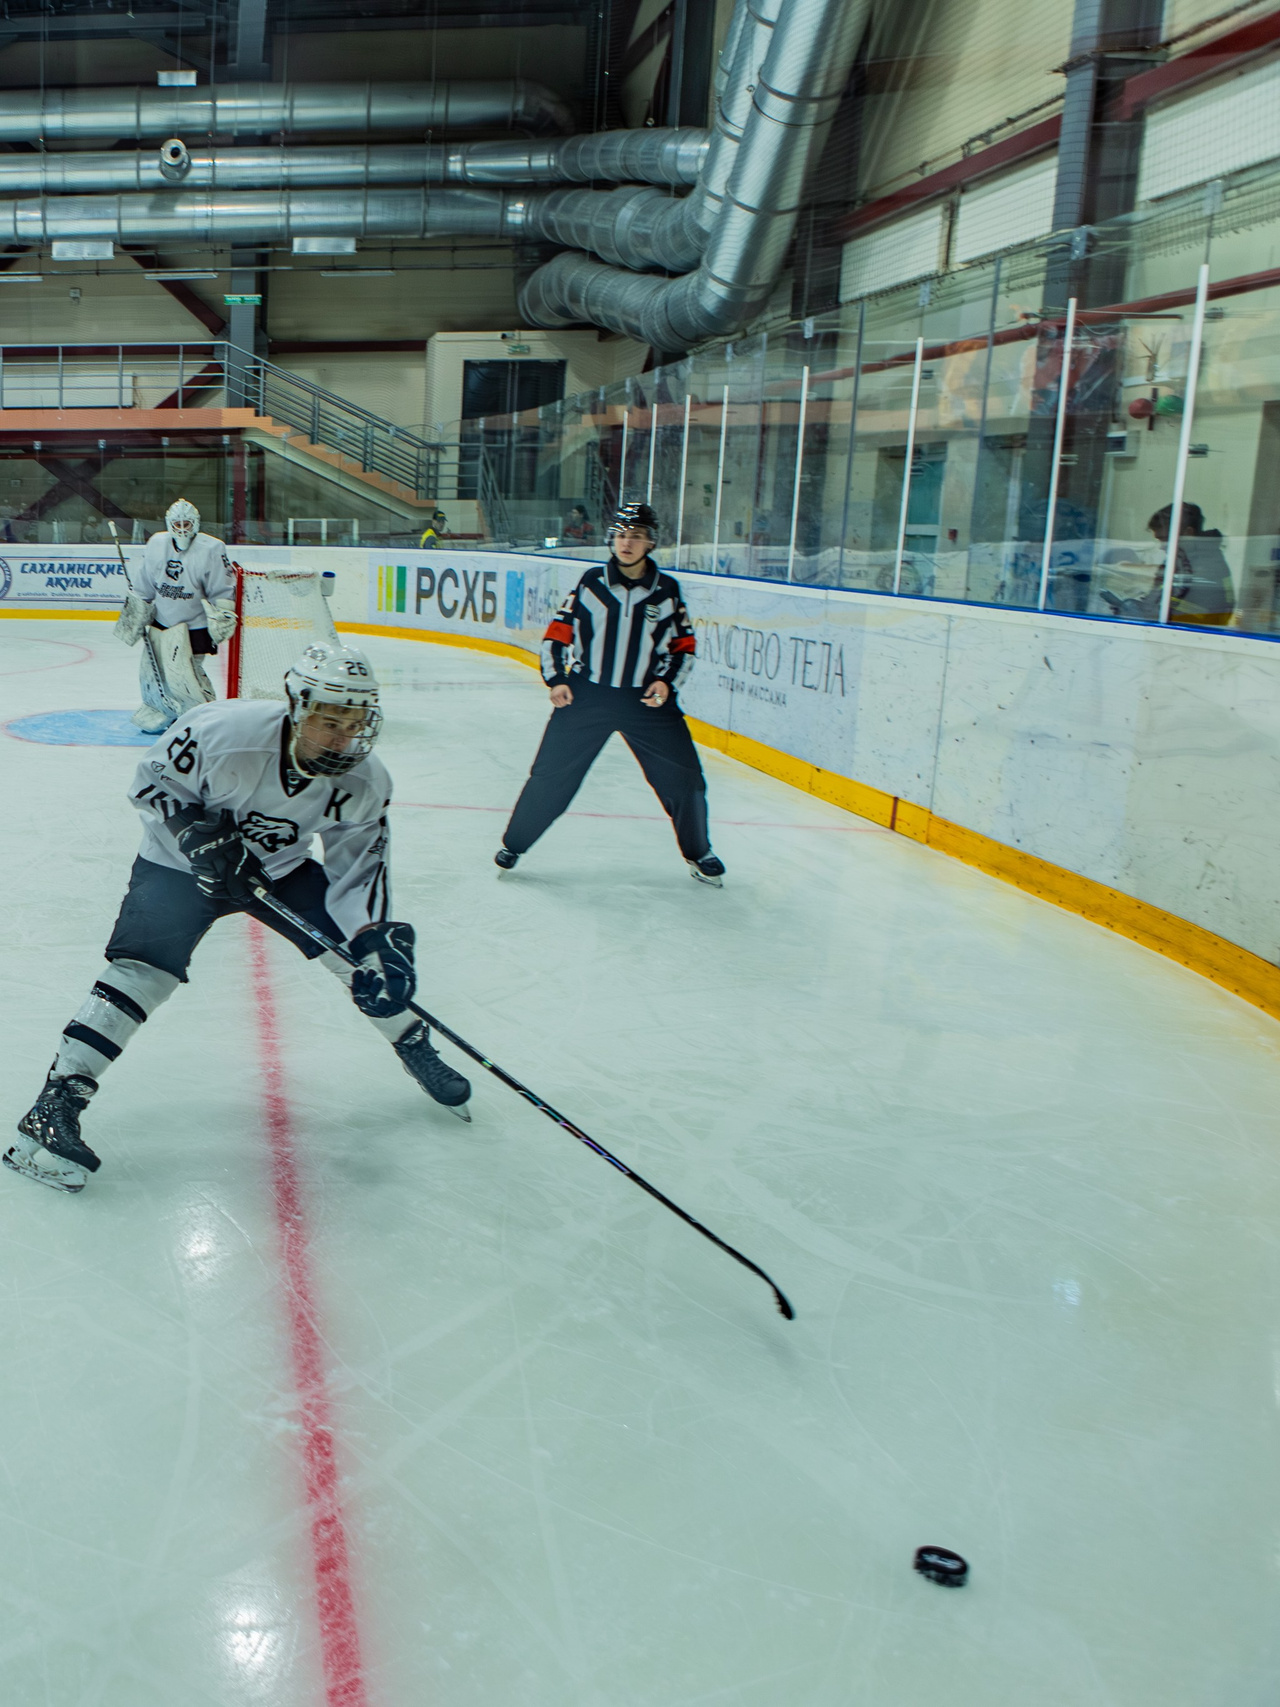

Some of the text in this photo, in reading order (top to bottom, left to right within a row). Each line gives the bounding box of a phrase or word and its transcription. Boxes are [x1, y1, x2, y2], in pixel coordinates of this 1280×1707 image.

[21, 562, 124, 578] САХАЛИНСКИЕ
[45, 577, 92, 591] АКУЛЫ
[415, 566, 498, 623] РСХБ
[345, 661, 368, 676] 26
[790, 636, 845, 697] ТЕЛА
[167, 727, 198, 774] 26
